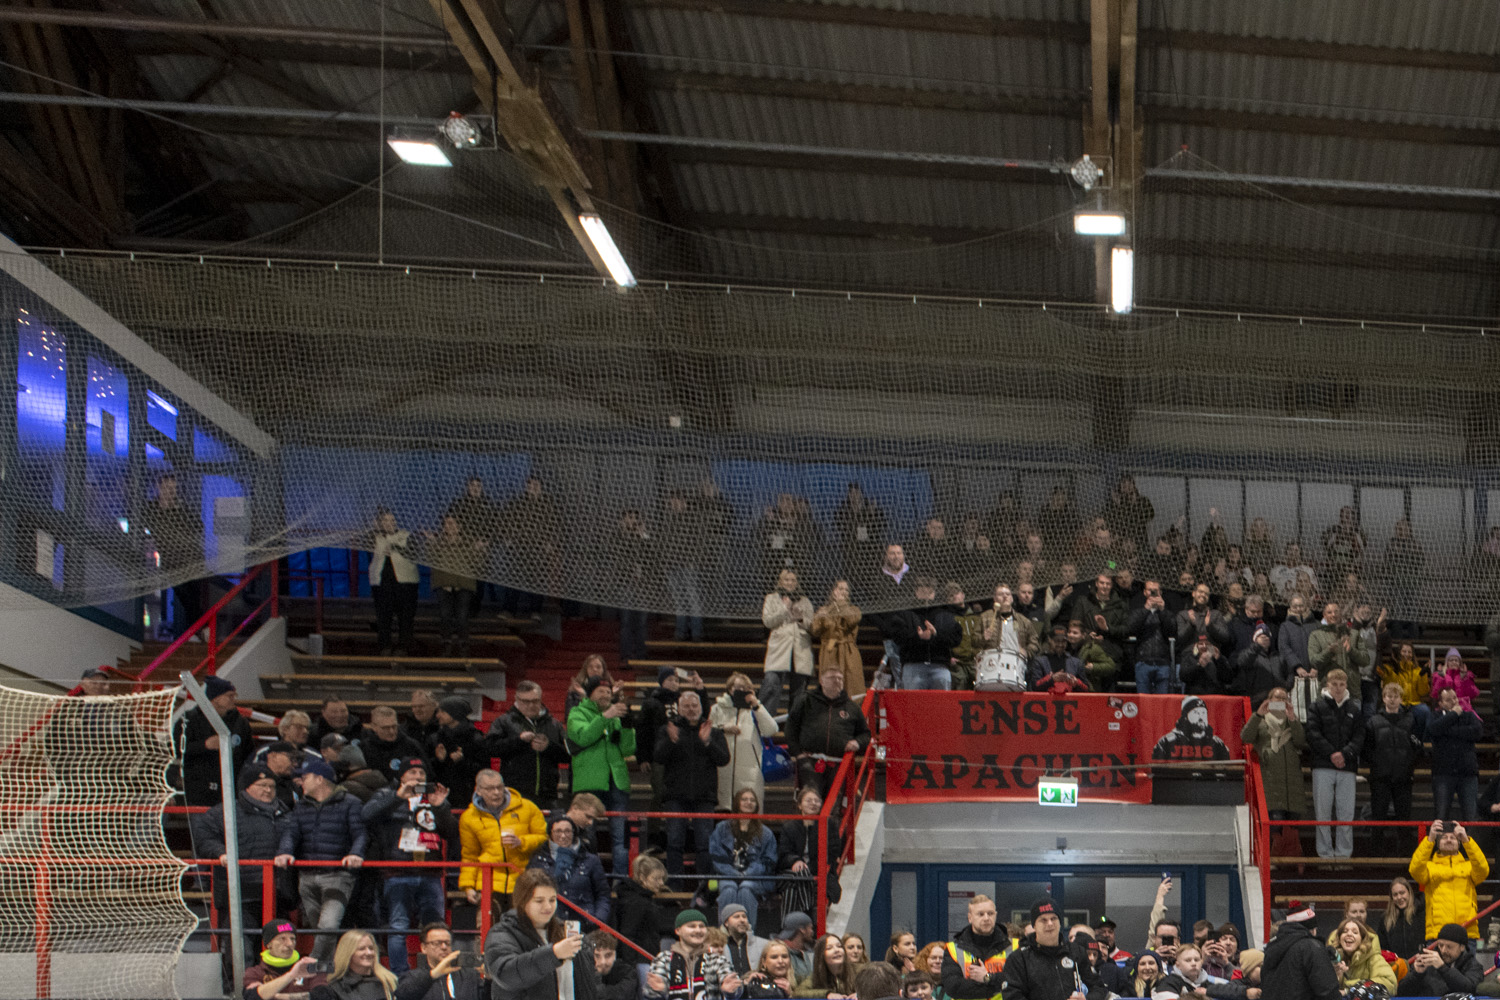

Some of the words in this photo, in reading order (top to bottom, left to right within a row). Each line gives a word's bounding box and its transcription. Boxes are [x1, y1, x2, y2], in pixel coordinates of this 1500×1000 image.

[959, 700, 1081, 736] ENSE
[1170, 745, 1214, 758] JB16
[902, 753, 1139, 790] APACHEN
